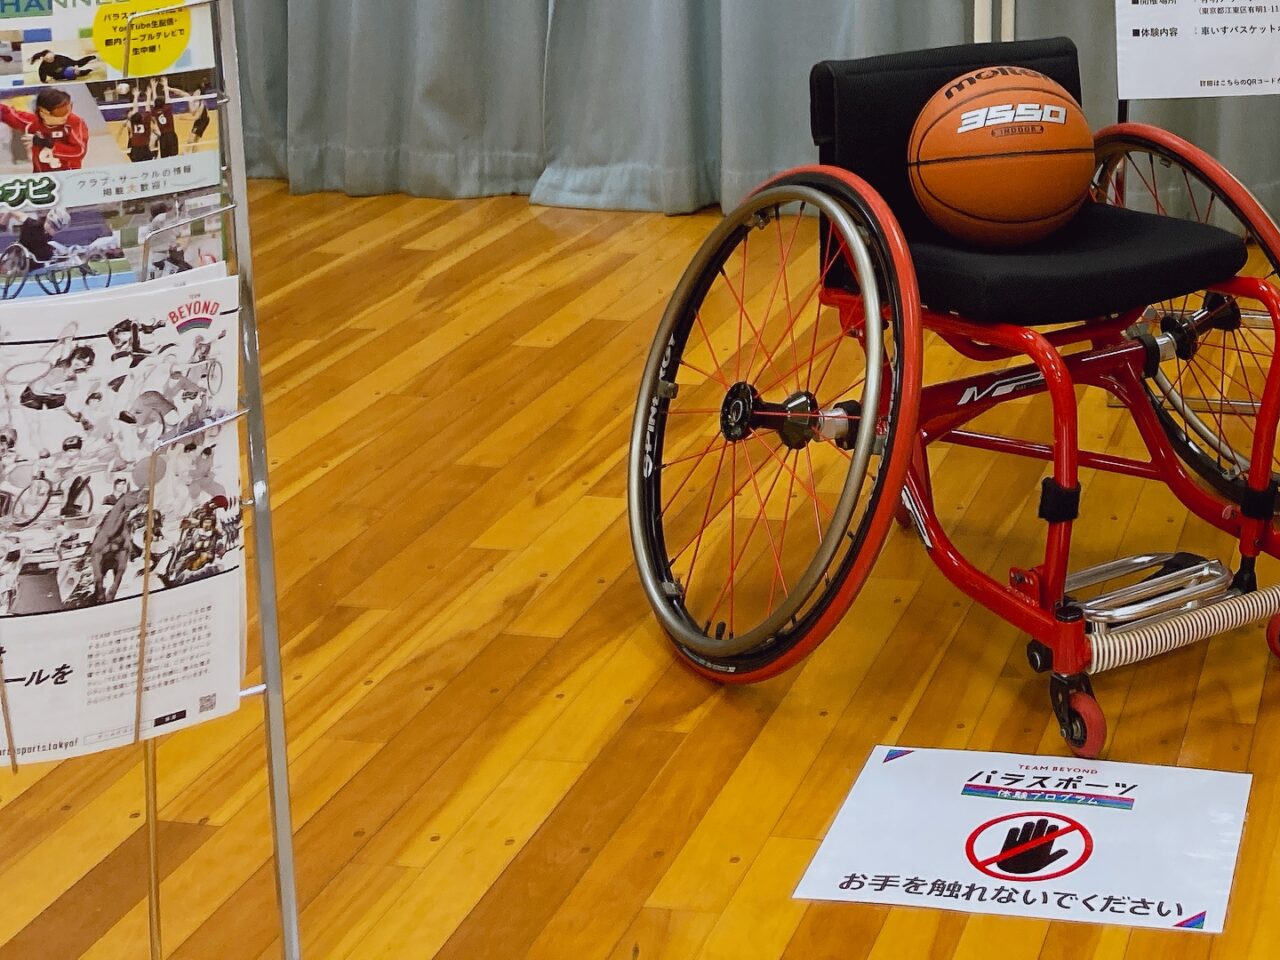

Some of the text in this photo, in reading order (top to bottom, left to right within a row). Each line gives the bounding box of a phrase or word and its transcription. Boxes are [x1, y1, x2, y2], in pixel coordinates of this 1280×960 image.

[1140, 26, 1179, 38] 体験内容
[168, 300, 220, 324] BEYOND
[1018, 763, 1099, 775] TEAM BEYOND
[966, 770, 1138, 796] パラスポーツ
[996, 788, 1100, 805] 体験プログラム
[838, 873, 1184, 918] お手を触れないでください
